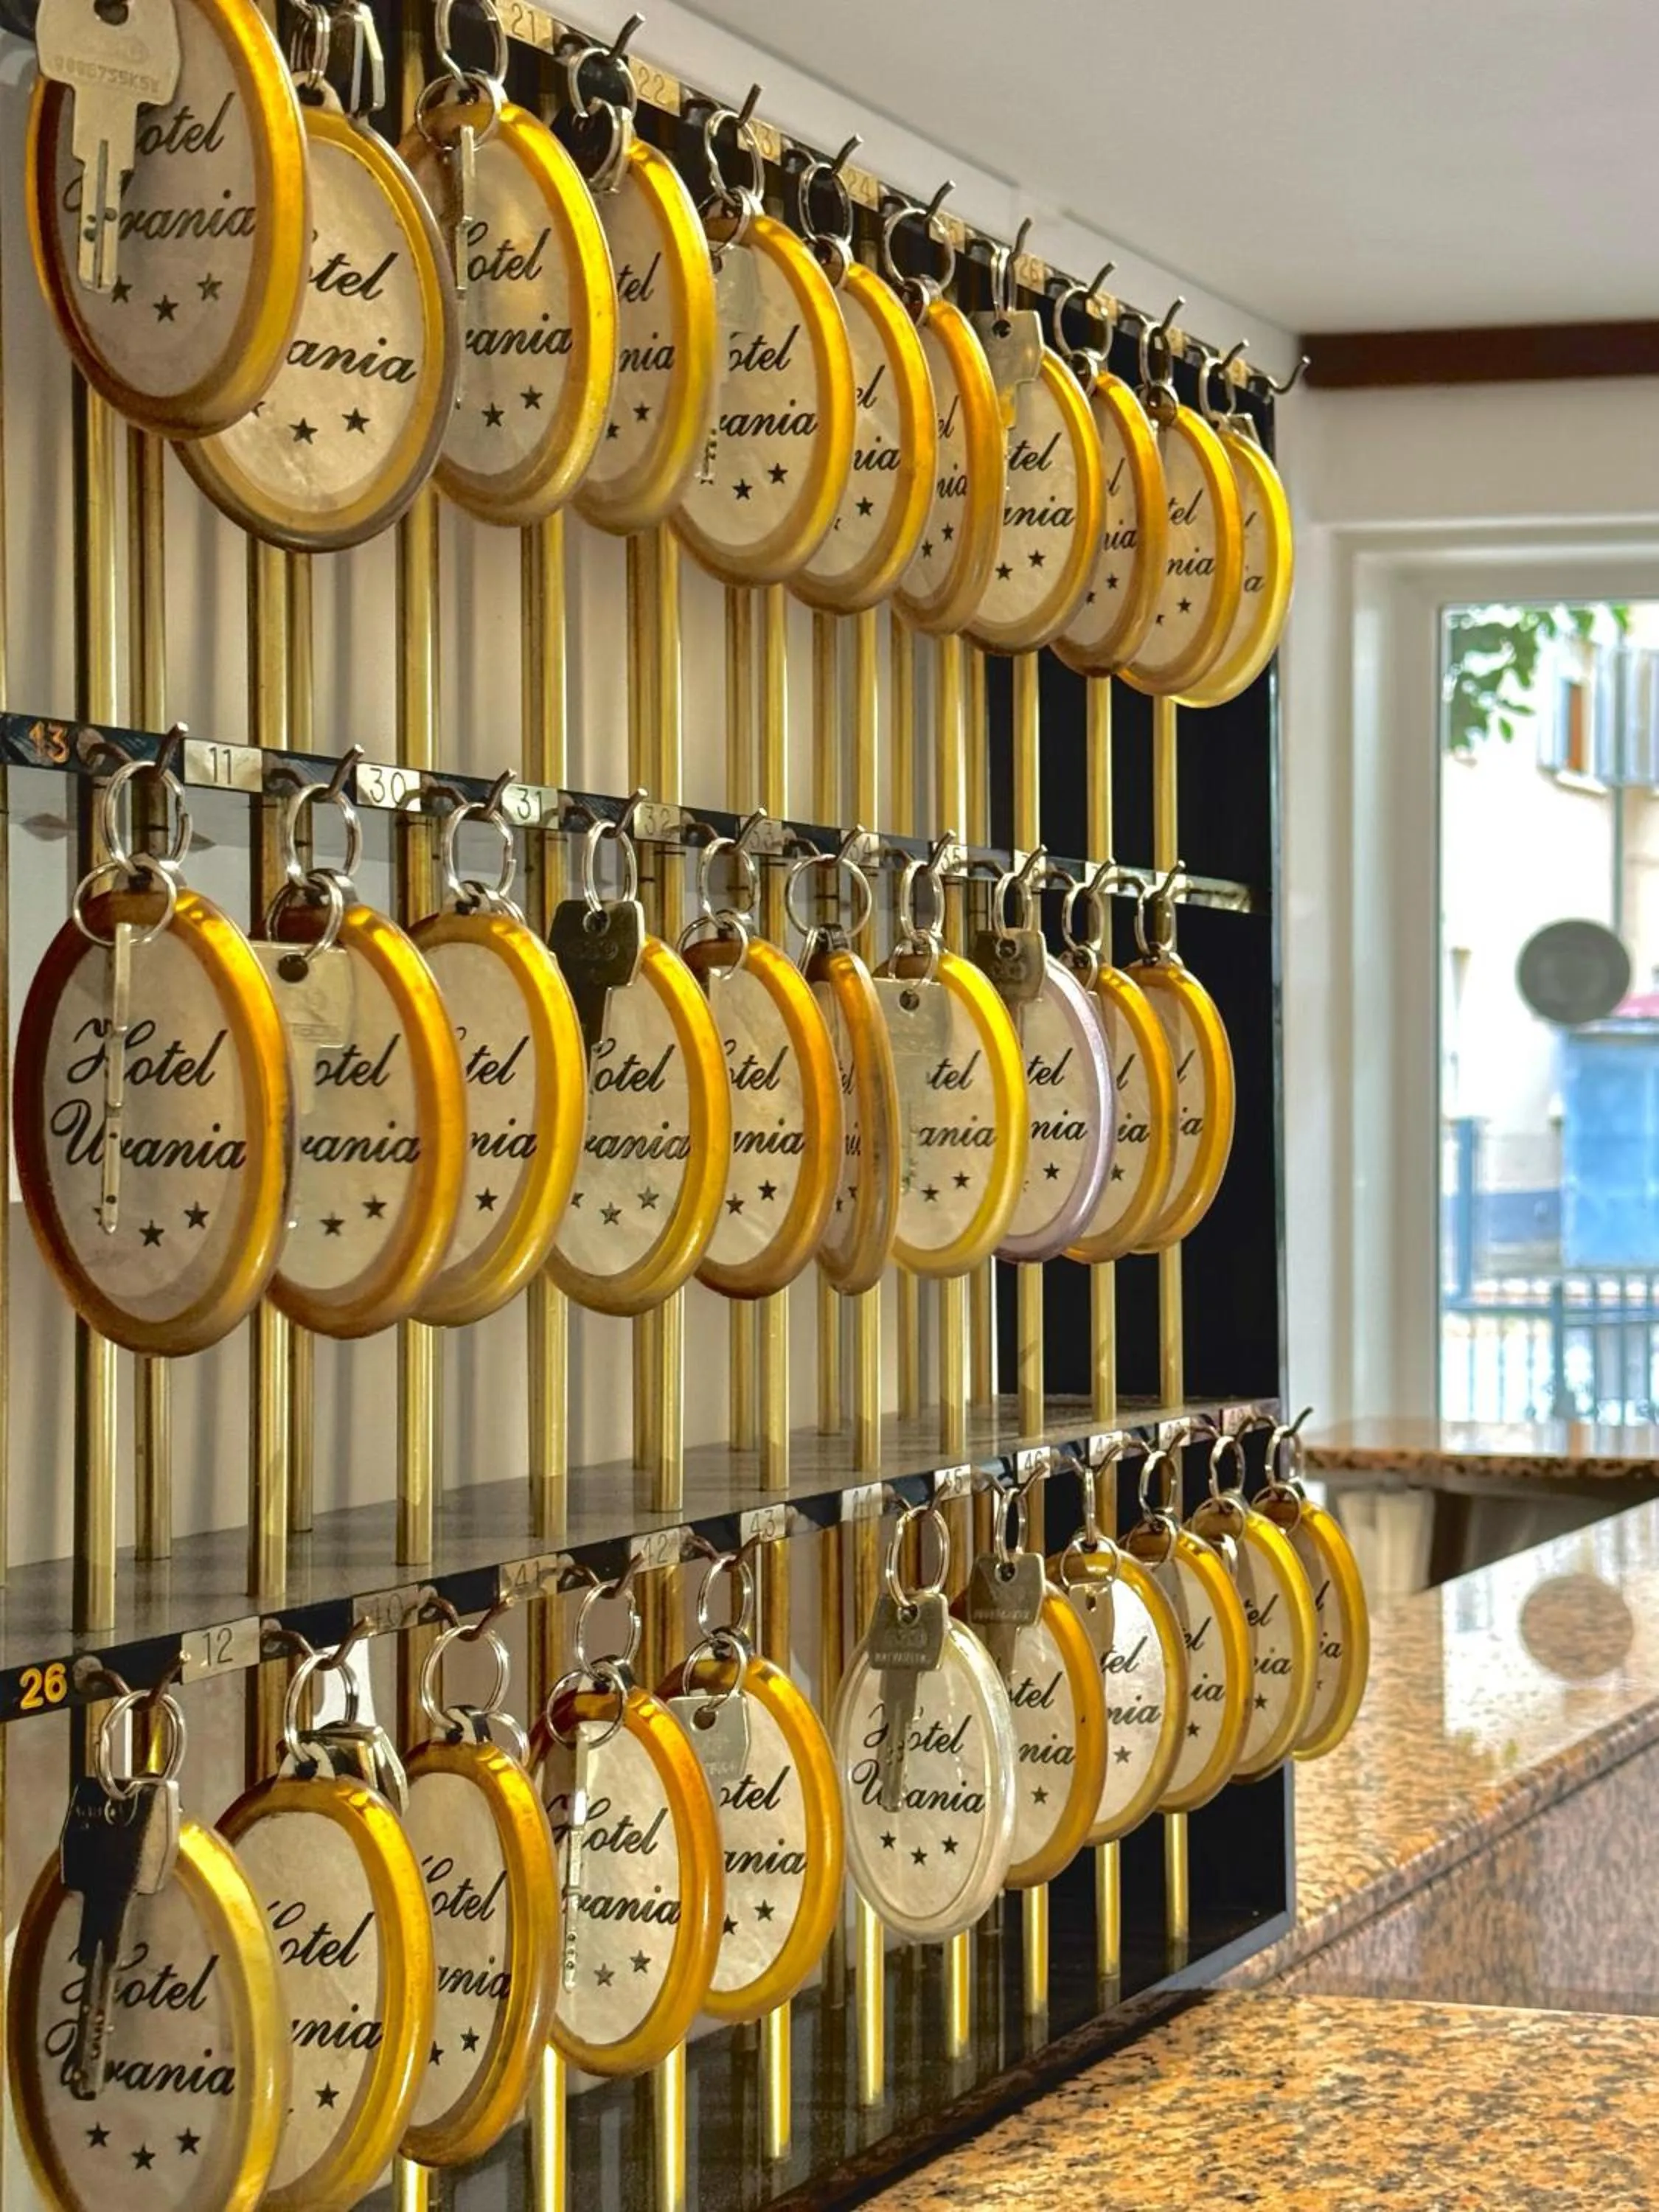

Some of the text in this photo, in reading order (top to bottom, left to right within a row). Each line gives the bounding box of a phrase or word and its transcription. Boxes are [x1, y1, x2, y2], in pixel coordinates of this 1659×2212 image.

[511, 3, 536, 44] 21
[639, 66, 667, 105] 22
[135, 91, 236, 156] otel
[308, 251, 399, 302] tel
[616, 251, 663, 303] tel
[286, 336, 417, 384] ania
[619, 332, 676, 372] nia
[728, 324, 800, 375] otel
[1008, 432, 1062, 471] tel
[1168, 488, 1203, 526] tel
[1166, 546, 1215, 577] nia
[209, 746, 232, 785] 11
[369, 768, 407, 805] 30
[517, 788, 543, 822] 31
[315, 1032, 402, 1088] otel
[465, 1034, 531, 1087] tel
[927, 1049, 981, 1091] tel
[1027, 1047, 1074, 1086] tel
[470, 1116, 538, 1159] nia
[918, 1114, 998, 1147] ania
[1031, 1108, 1088, 1141] nia
[750, 1509, 776, 1538] 43
[202, 1627, 233, 1666] 12
[1100, 1636, 1149, 1674] tel
[20, 1662, 68, 1710] 26
[1007, 1671, 1063, 1710] tel
[1106, 1694, 1163, 1726] nia
[1018, 1733, 1077, 1766] nia
[720, 1764, 790, 1810] otel
[851, 1758, 987, 1814] Uania
[579, 1884, 681, 1925] rania
